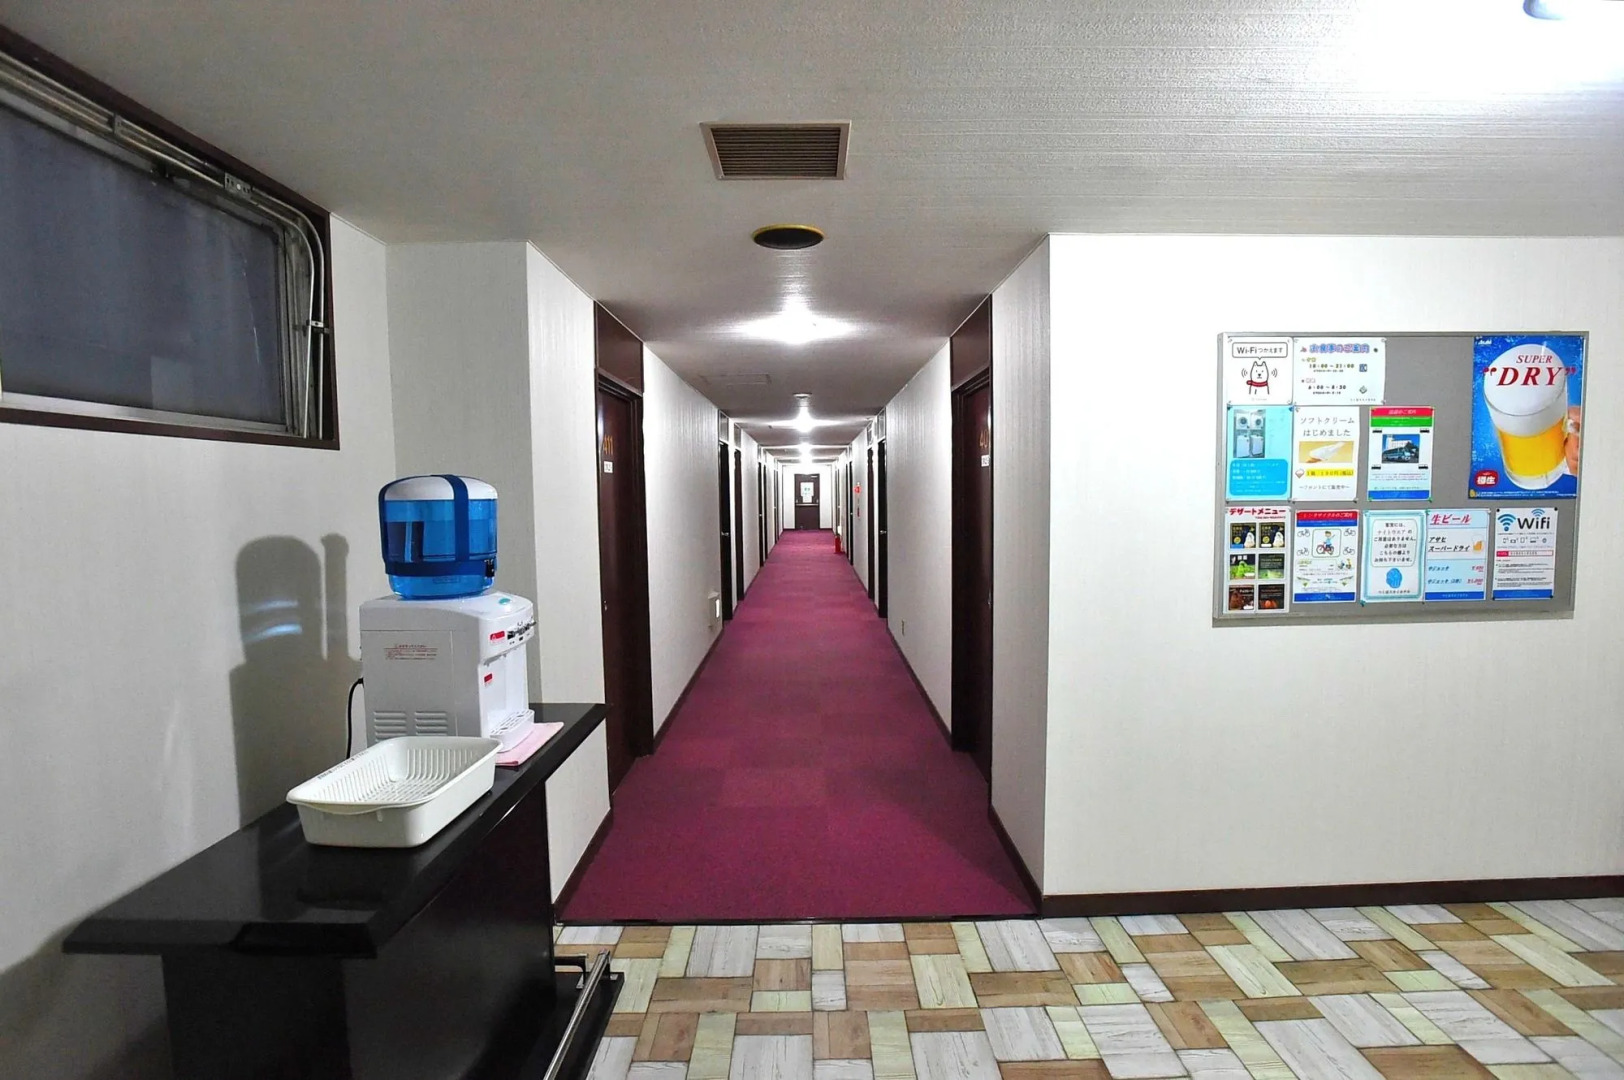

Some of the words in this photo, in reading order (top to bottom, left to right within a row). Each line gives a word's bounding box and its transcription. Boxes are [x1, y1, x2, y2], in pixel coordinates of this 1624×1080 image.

[1516, 355, 1553, 364] SUPER
[1301, 417, 1355, 425] ソフトクリーム
[1303, 429, 1351, 437] はじめました
[1431, 514, 1471, 525] 生ビール
[1517, 516, 1550, 530] Wifi
